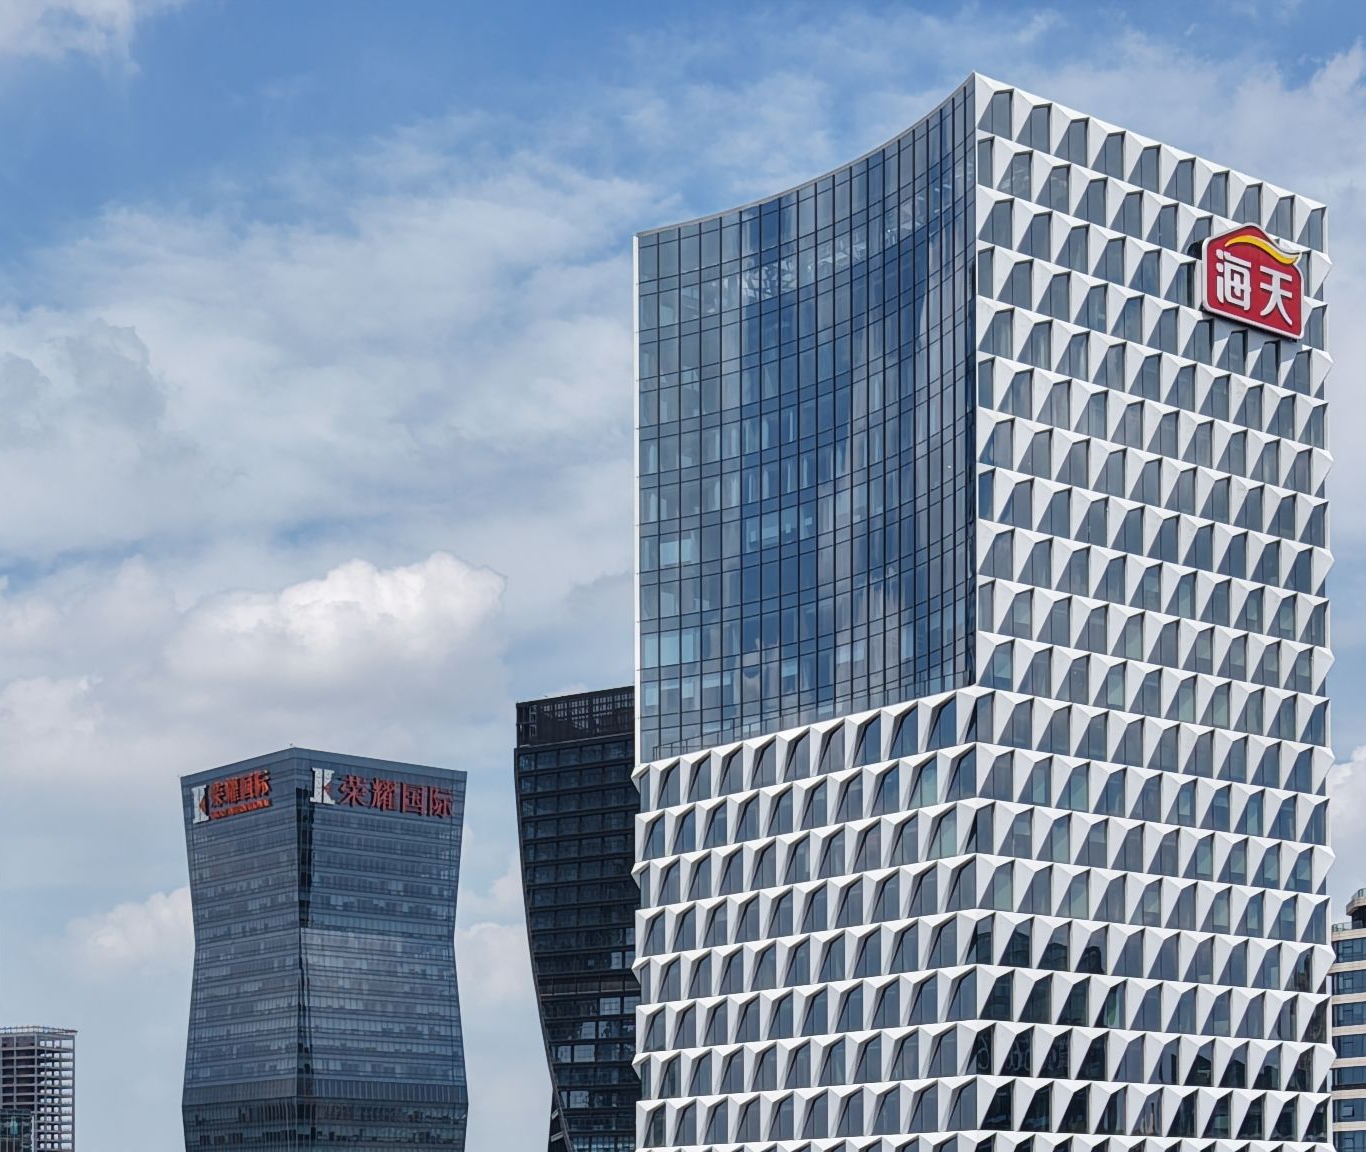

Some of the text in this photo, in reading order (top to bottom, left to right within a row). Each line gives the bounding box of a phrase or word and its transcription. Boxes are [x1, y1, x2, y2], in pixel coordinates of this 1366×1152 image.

[1215, 249, 1293, 326] 海天
[339, 775, 453, 819] 荣耀国际
